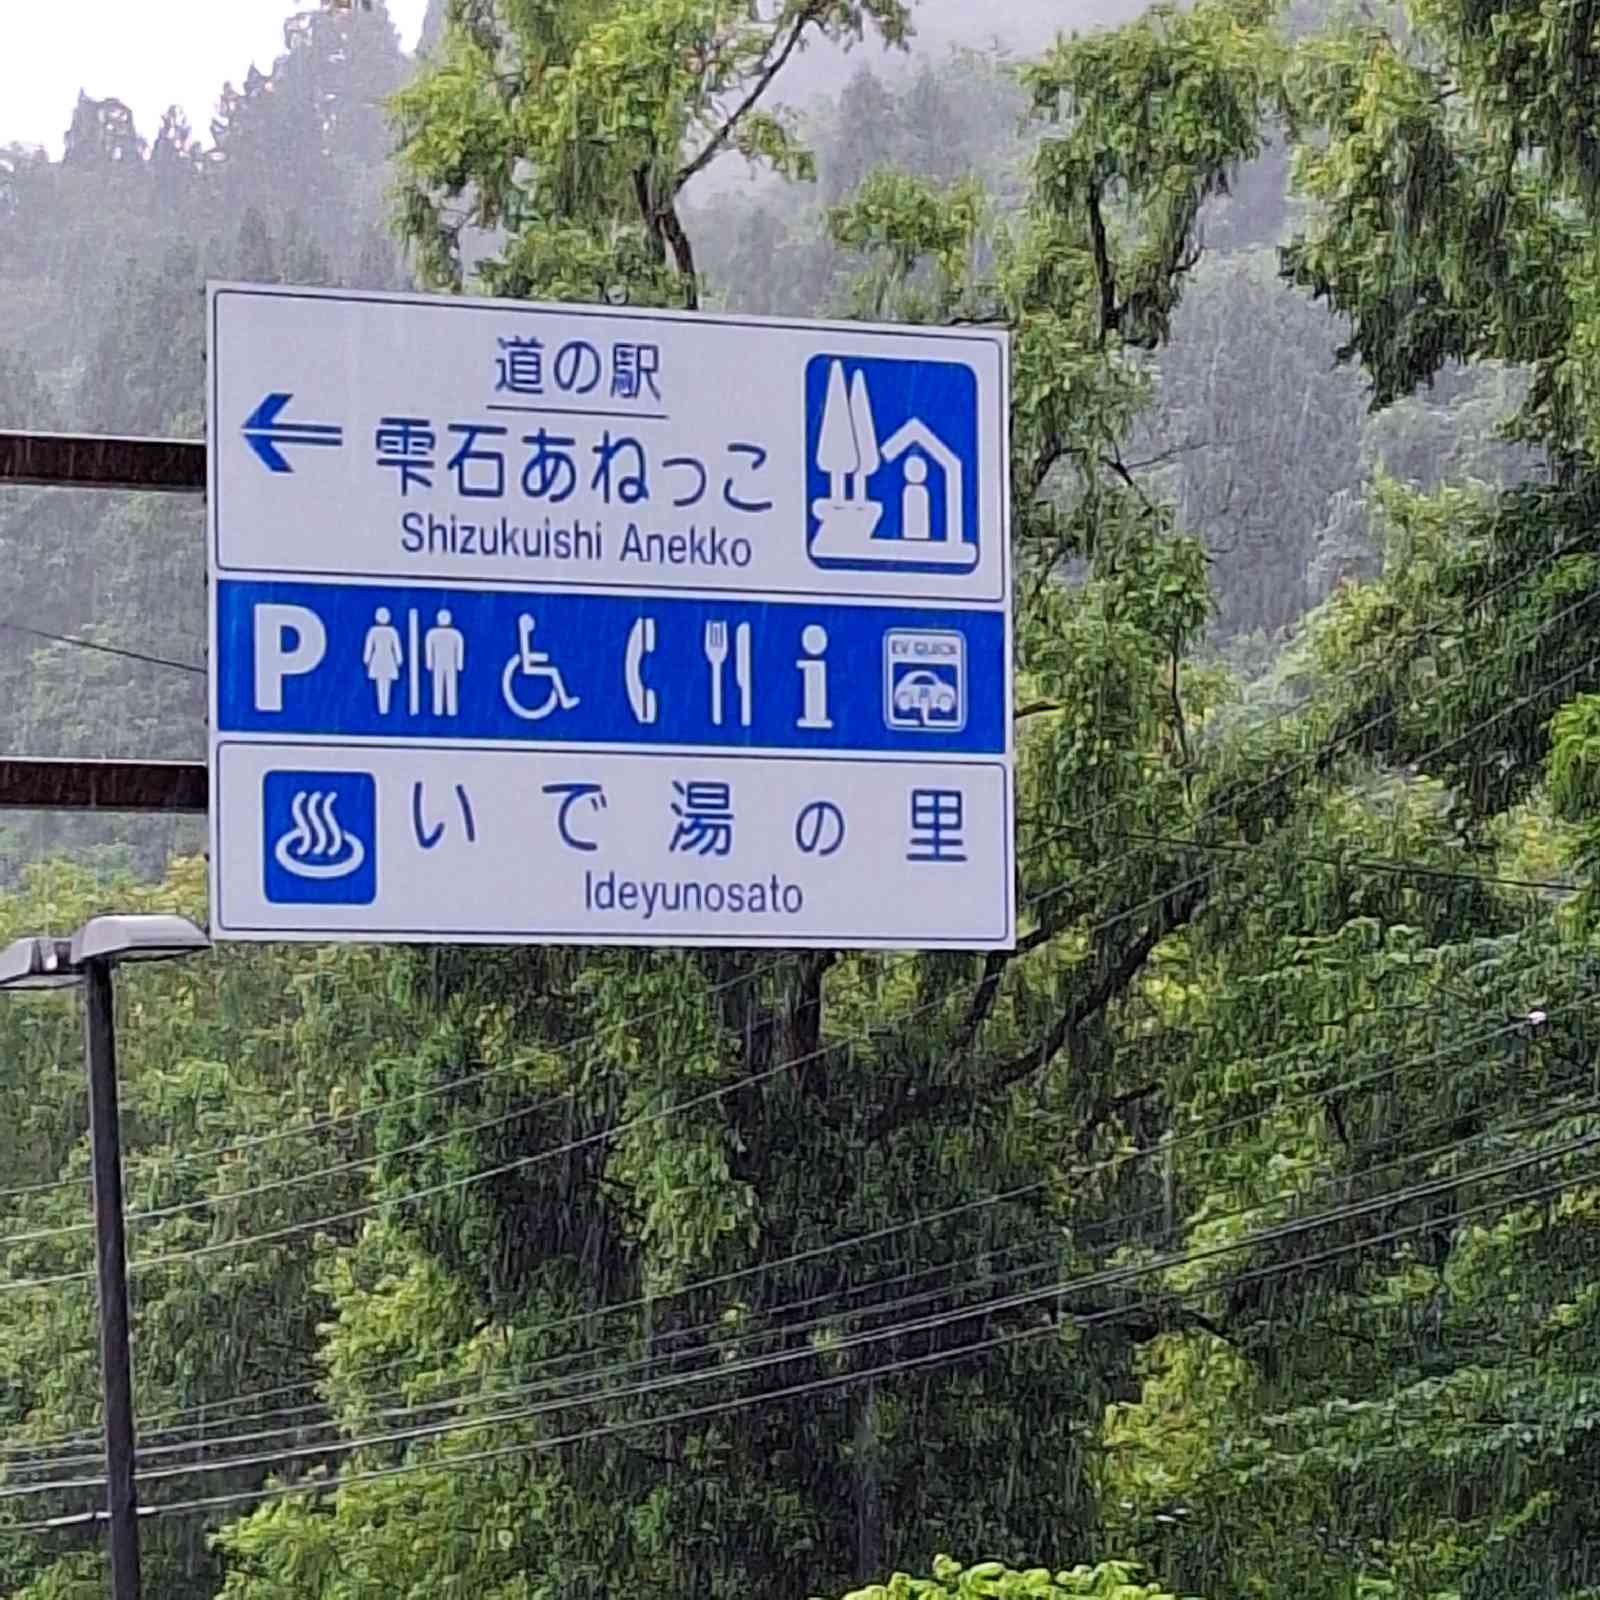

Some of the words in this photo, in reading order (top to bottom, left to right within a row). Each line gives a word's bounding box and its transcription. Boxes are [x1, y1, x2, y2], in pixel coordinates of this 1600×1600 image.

[495, 335, 661, 401] 道の駅
[375, 417, 773, 513] 雫石あねっこ
[401, 511, 603, 561] Shizukuishi
[619, 523, 752, 567] Anekko
[253, 604, 327, 712] P
[413, 780, 968, 863] いで湯の里
[585, 870, 803, 920] Ideyunosato
